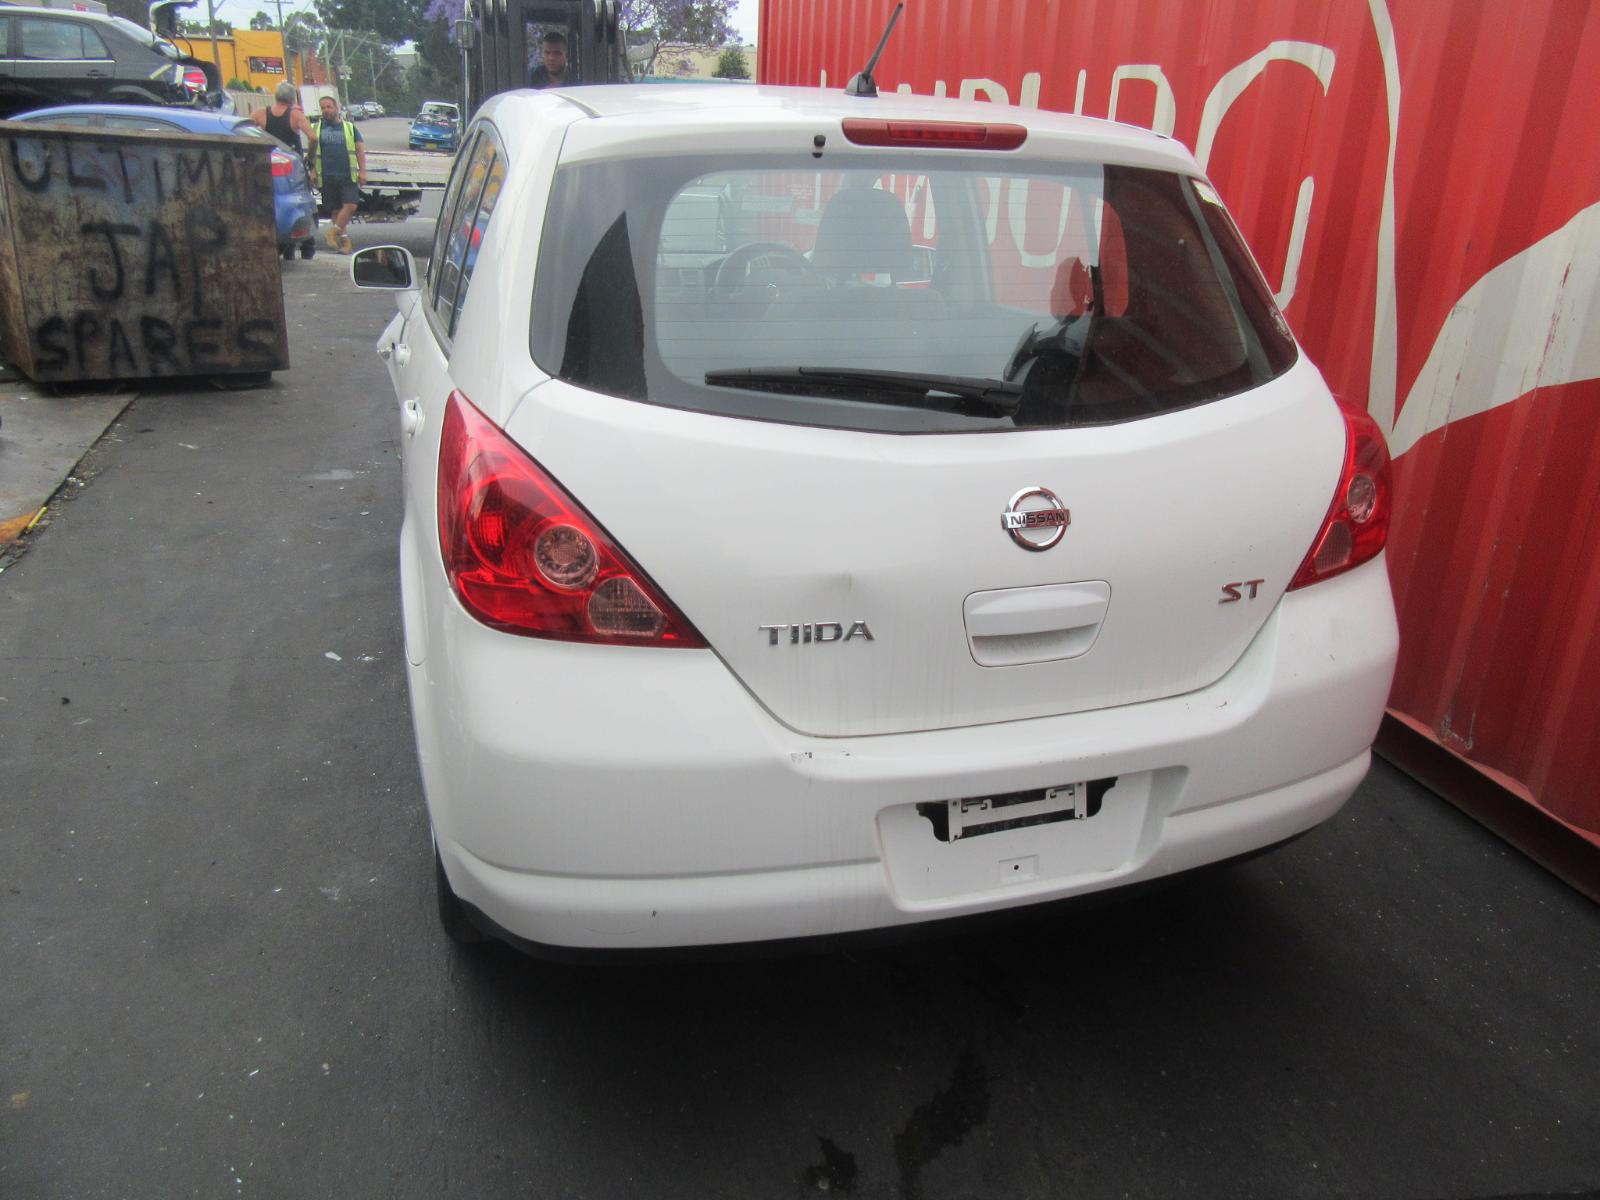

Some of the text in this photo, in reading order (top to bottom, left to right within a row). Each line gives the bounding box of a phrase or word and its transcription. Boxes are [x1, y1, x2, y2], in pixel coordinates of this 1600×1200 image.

[11, 136, 272, 206] ULTIMATE
[80, 207, 229, 316] JAP
[35, 309, 281, 374] SPARES
[1010, 511, 1065, 526] NISSAN
[1219, 578, 1265, 604] ST
